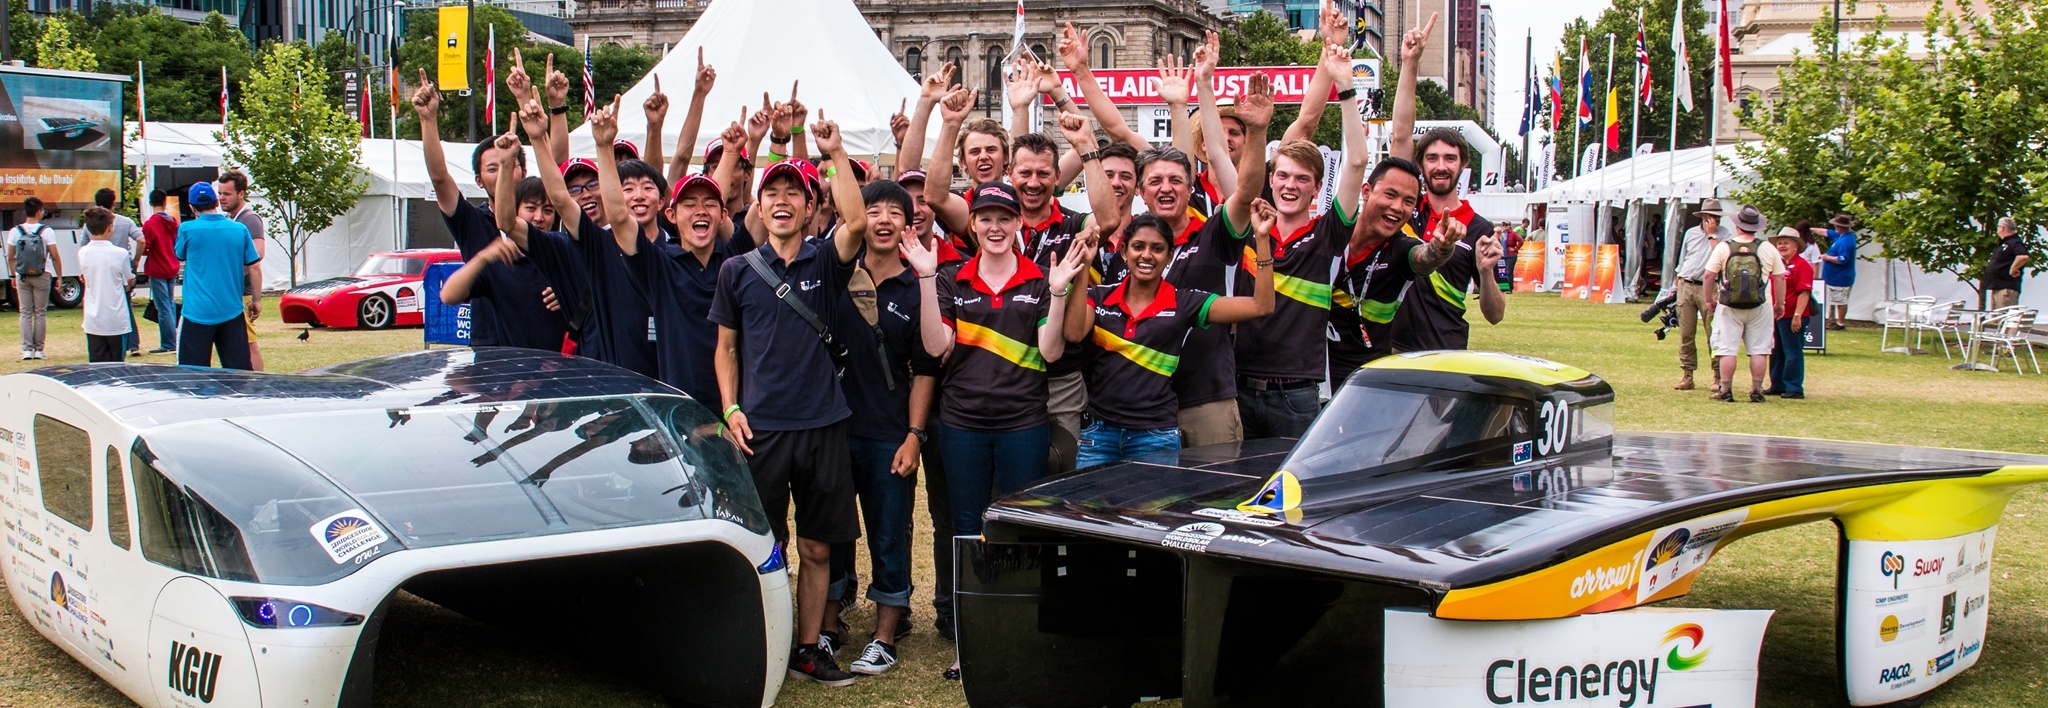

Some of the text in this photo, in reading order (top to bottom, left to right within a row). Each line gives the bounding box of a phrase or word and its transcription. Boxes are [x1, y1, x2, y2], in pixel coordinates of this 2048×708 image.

[39, 174, 52, 185] Abu
[53, 174, 73, 185] Dhabi
[16, 187, 35, 196] Class
[953, 296, 963, 306] 30
[1095, 307, 1105, 317] 30
[1537, 399, 1569, 456] 30
[331, 526, 373, 549] BRIDGESTONE
[338, 534, 383, 558] CHALLENGE
[1161, 539, 1207, 553] CHALLENGE
[1913, 556, 1944, 577] Sway
[169, 640, 222, 704] KGU
[1486, 657, 1660, 708] Clenergy
[1879, 663, 1911, 684] RACQ
